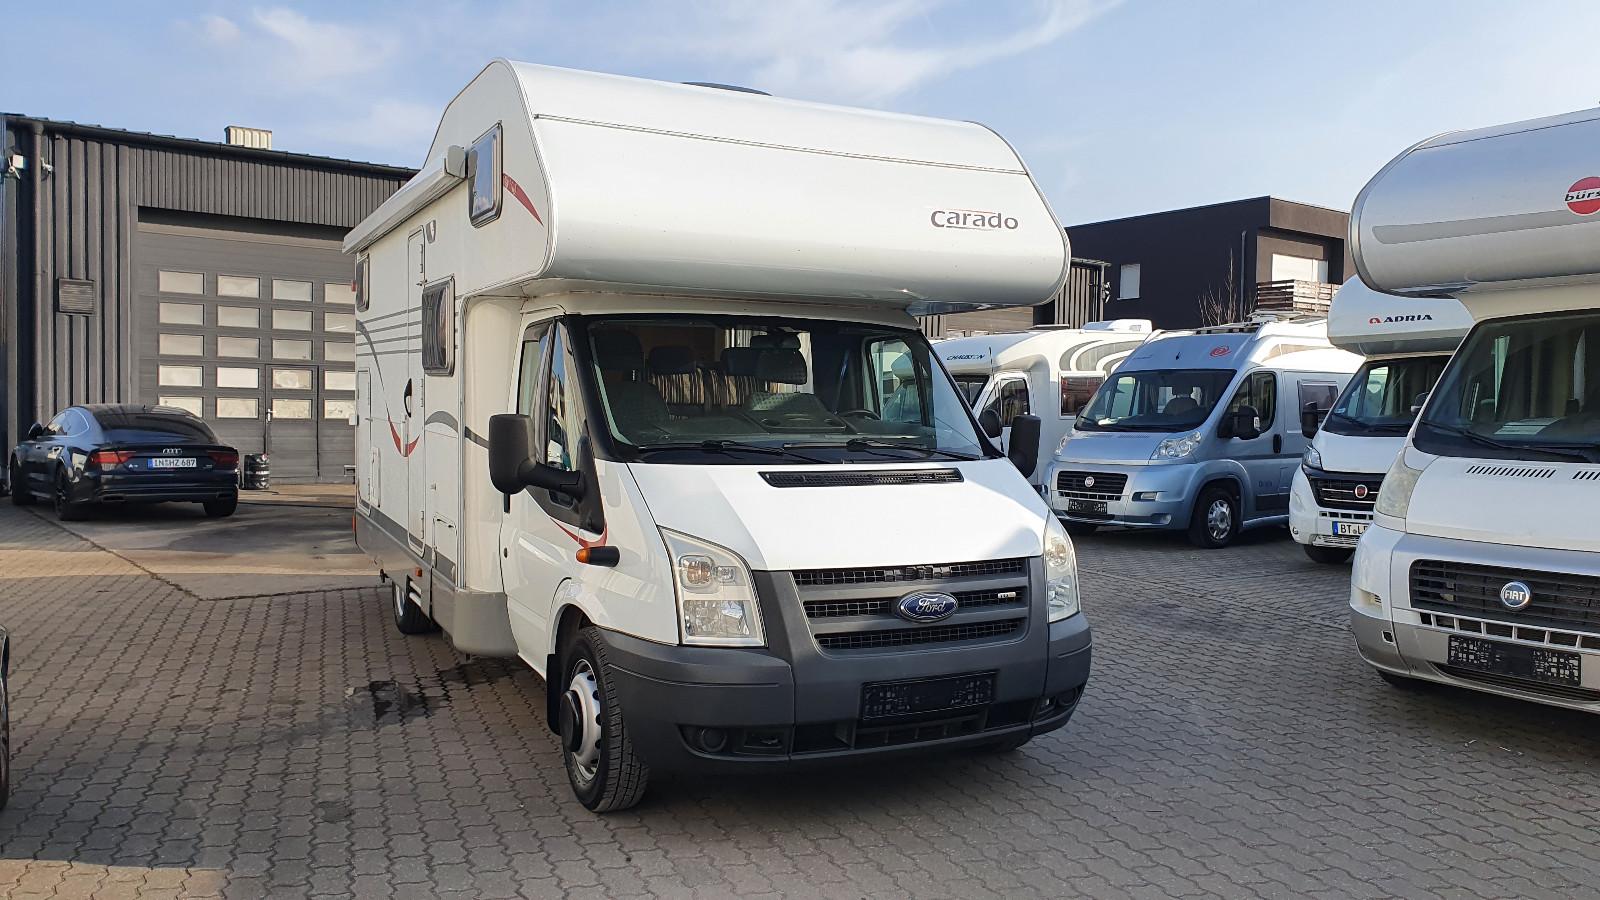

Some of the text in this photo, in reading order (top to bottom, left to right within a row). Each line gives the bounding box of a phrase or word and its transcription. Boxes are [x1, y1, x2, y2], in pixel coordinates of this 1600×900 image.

[930, 210, 1019, 230] Carado
[181, 459, 196, 467] 687
[1340, 524, 1352, 534] BT
[1504, 590, 1525, 600] FIAT
[916, 598, 946, 612] Ford
